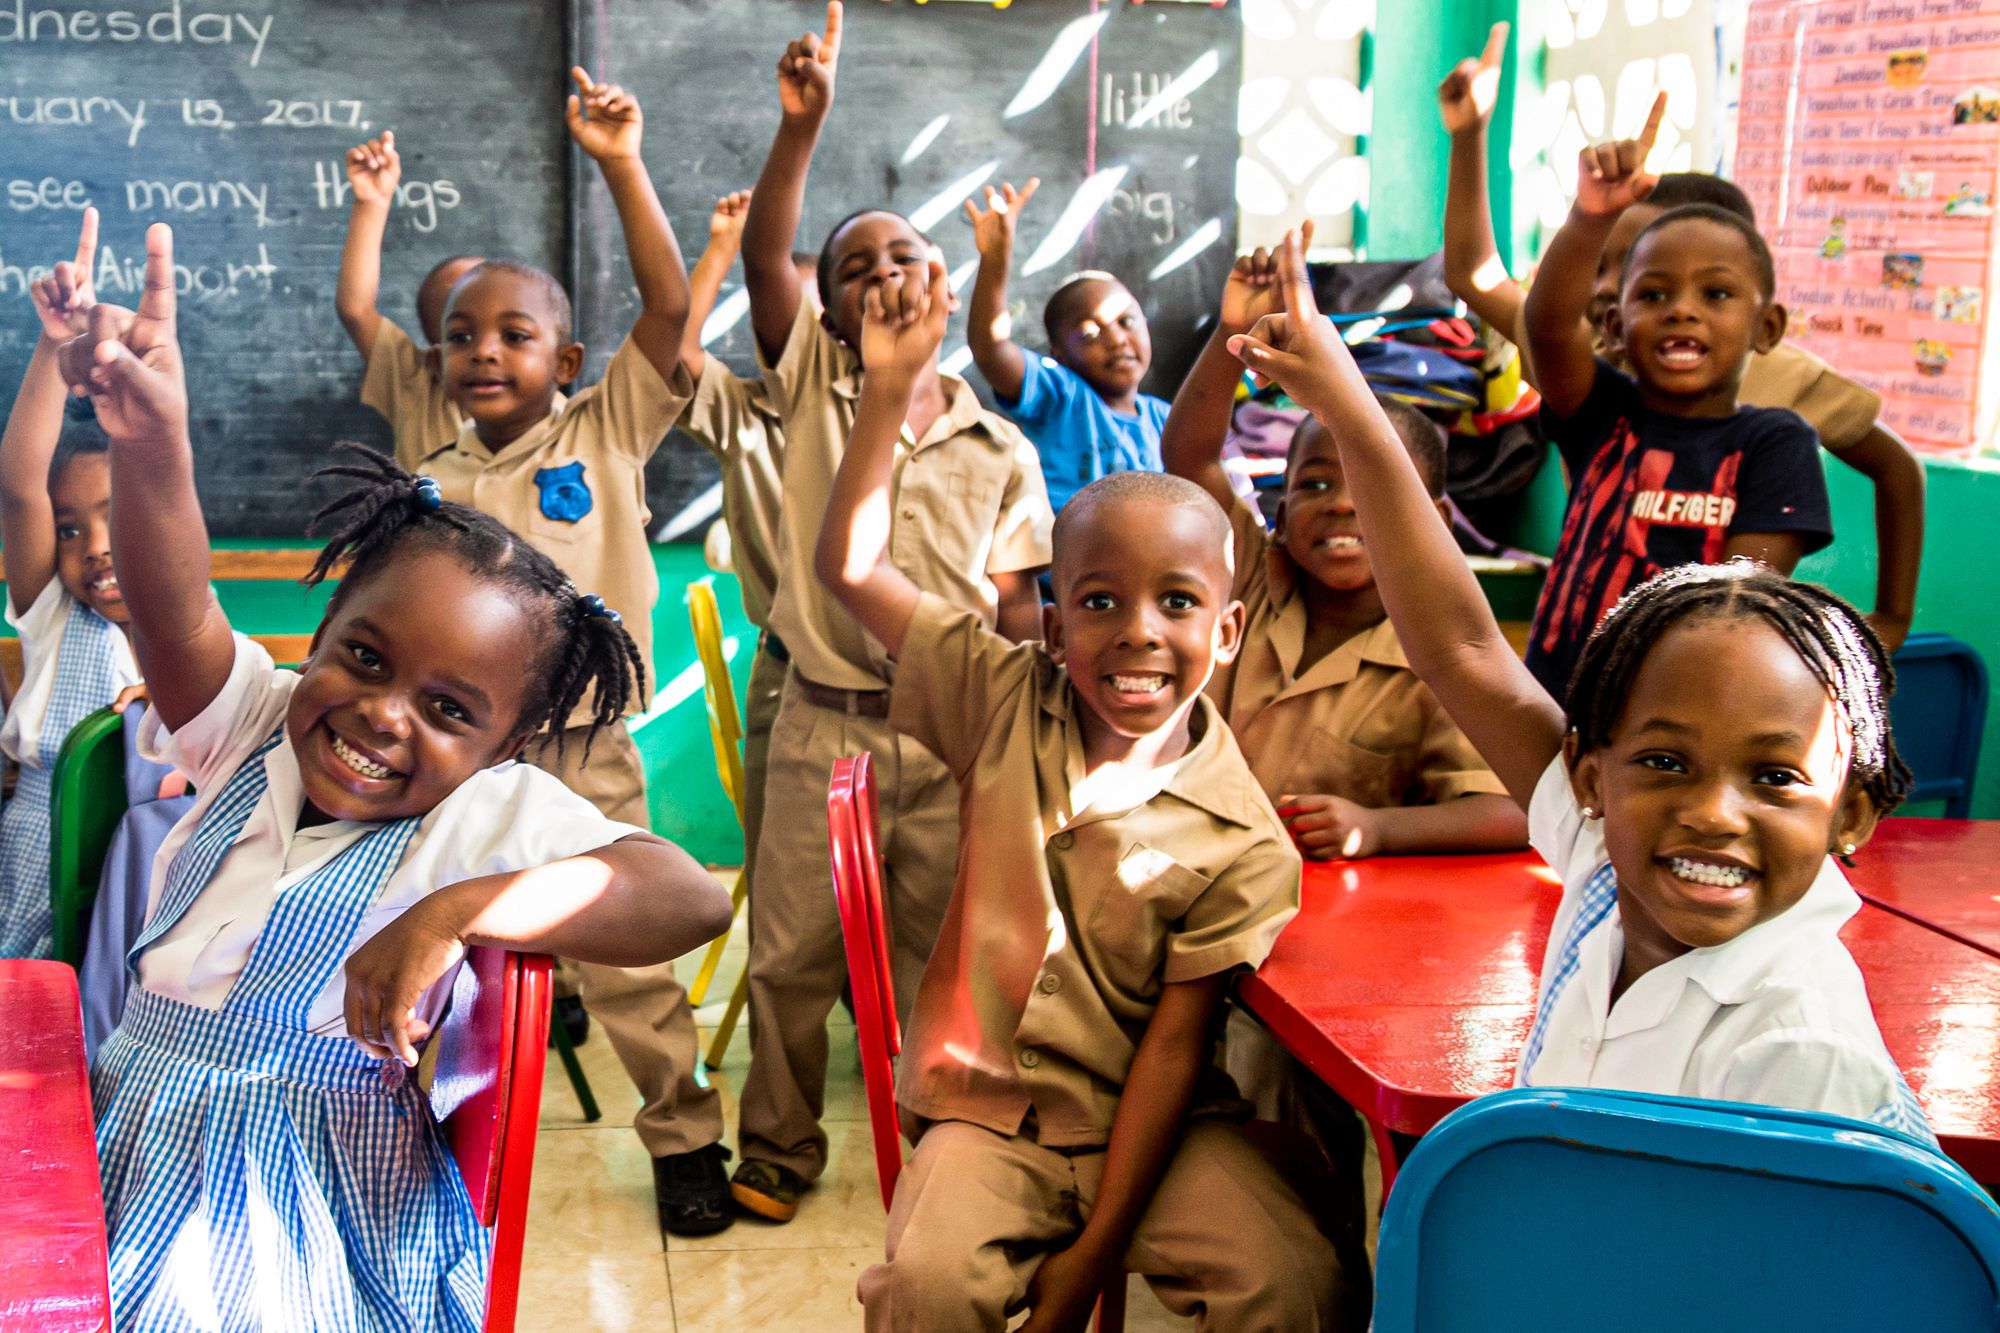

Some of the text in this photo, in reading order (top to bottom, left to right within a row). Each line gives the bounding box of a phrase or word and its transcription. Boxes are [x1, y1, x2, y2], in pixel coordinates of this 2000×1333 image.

[7, 161, 461, 233] see many thgs
[1806, 174, 1890, 195] Outdoor Play
[1842, 286, 1898, 312] Activity
[1809, 314, 1885, 336] Snack Time
[1632, 490, 1737, 528] HILFIGER
